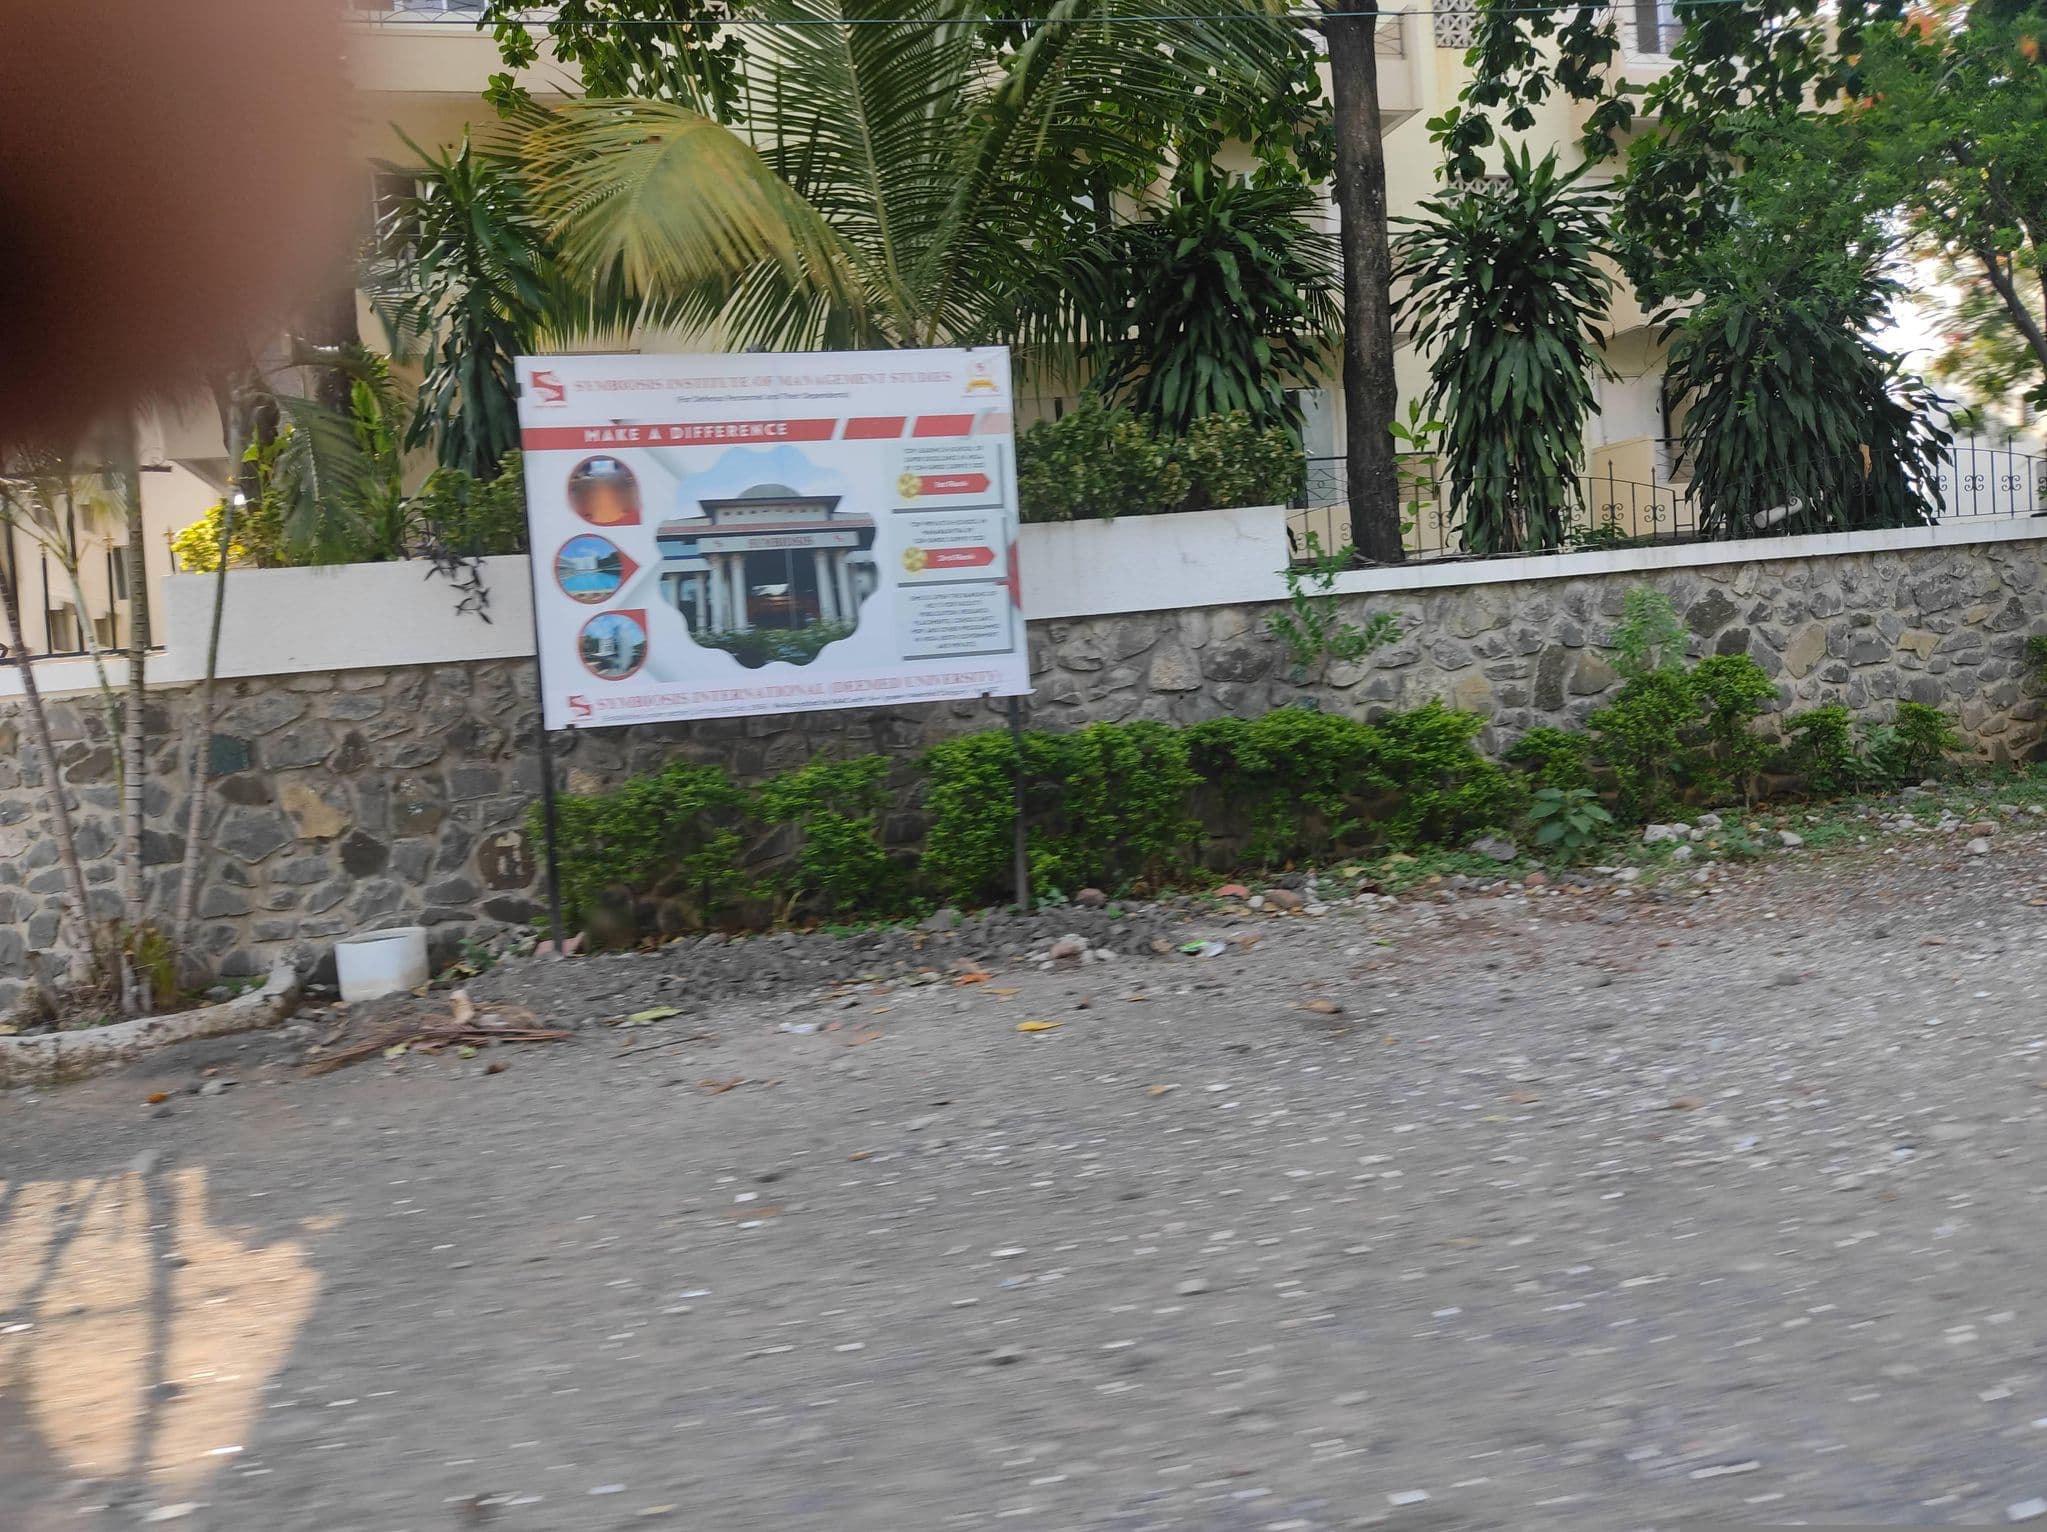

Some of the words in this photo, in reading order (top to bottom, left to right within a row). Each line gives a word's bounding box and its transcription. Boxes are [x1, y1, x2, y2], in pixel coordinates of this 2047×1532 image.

[583, 427, 641, 443] MAKE
[647, 426, 663, 441] A
[669, 422, 789, 440] DIFFERENCE
